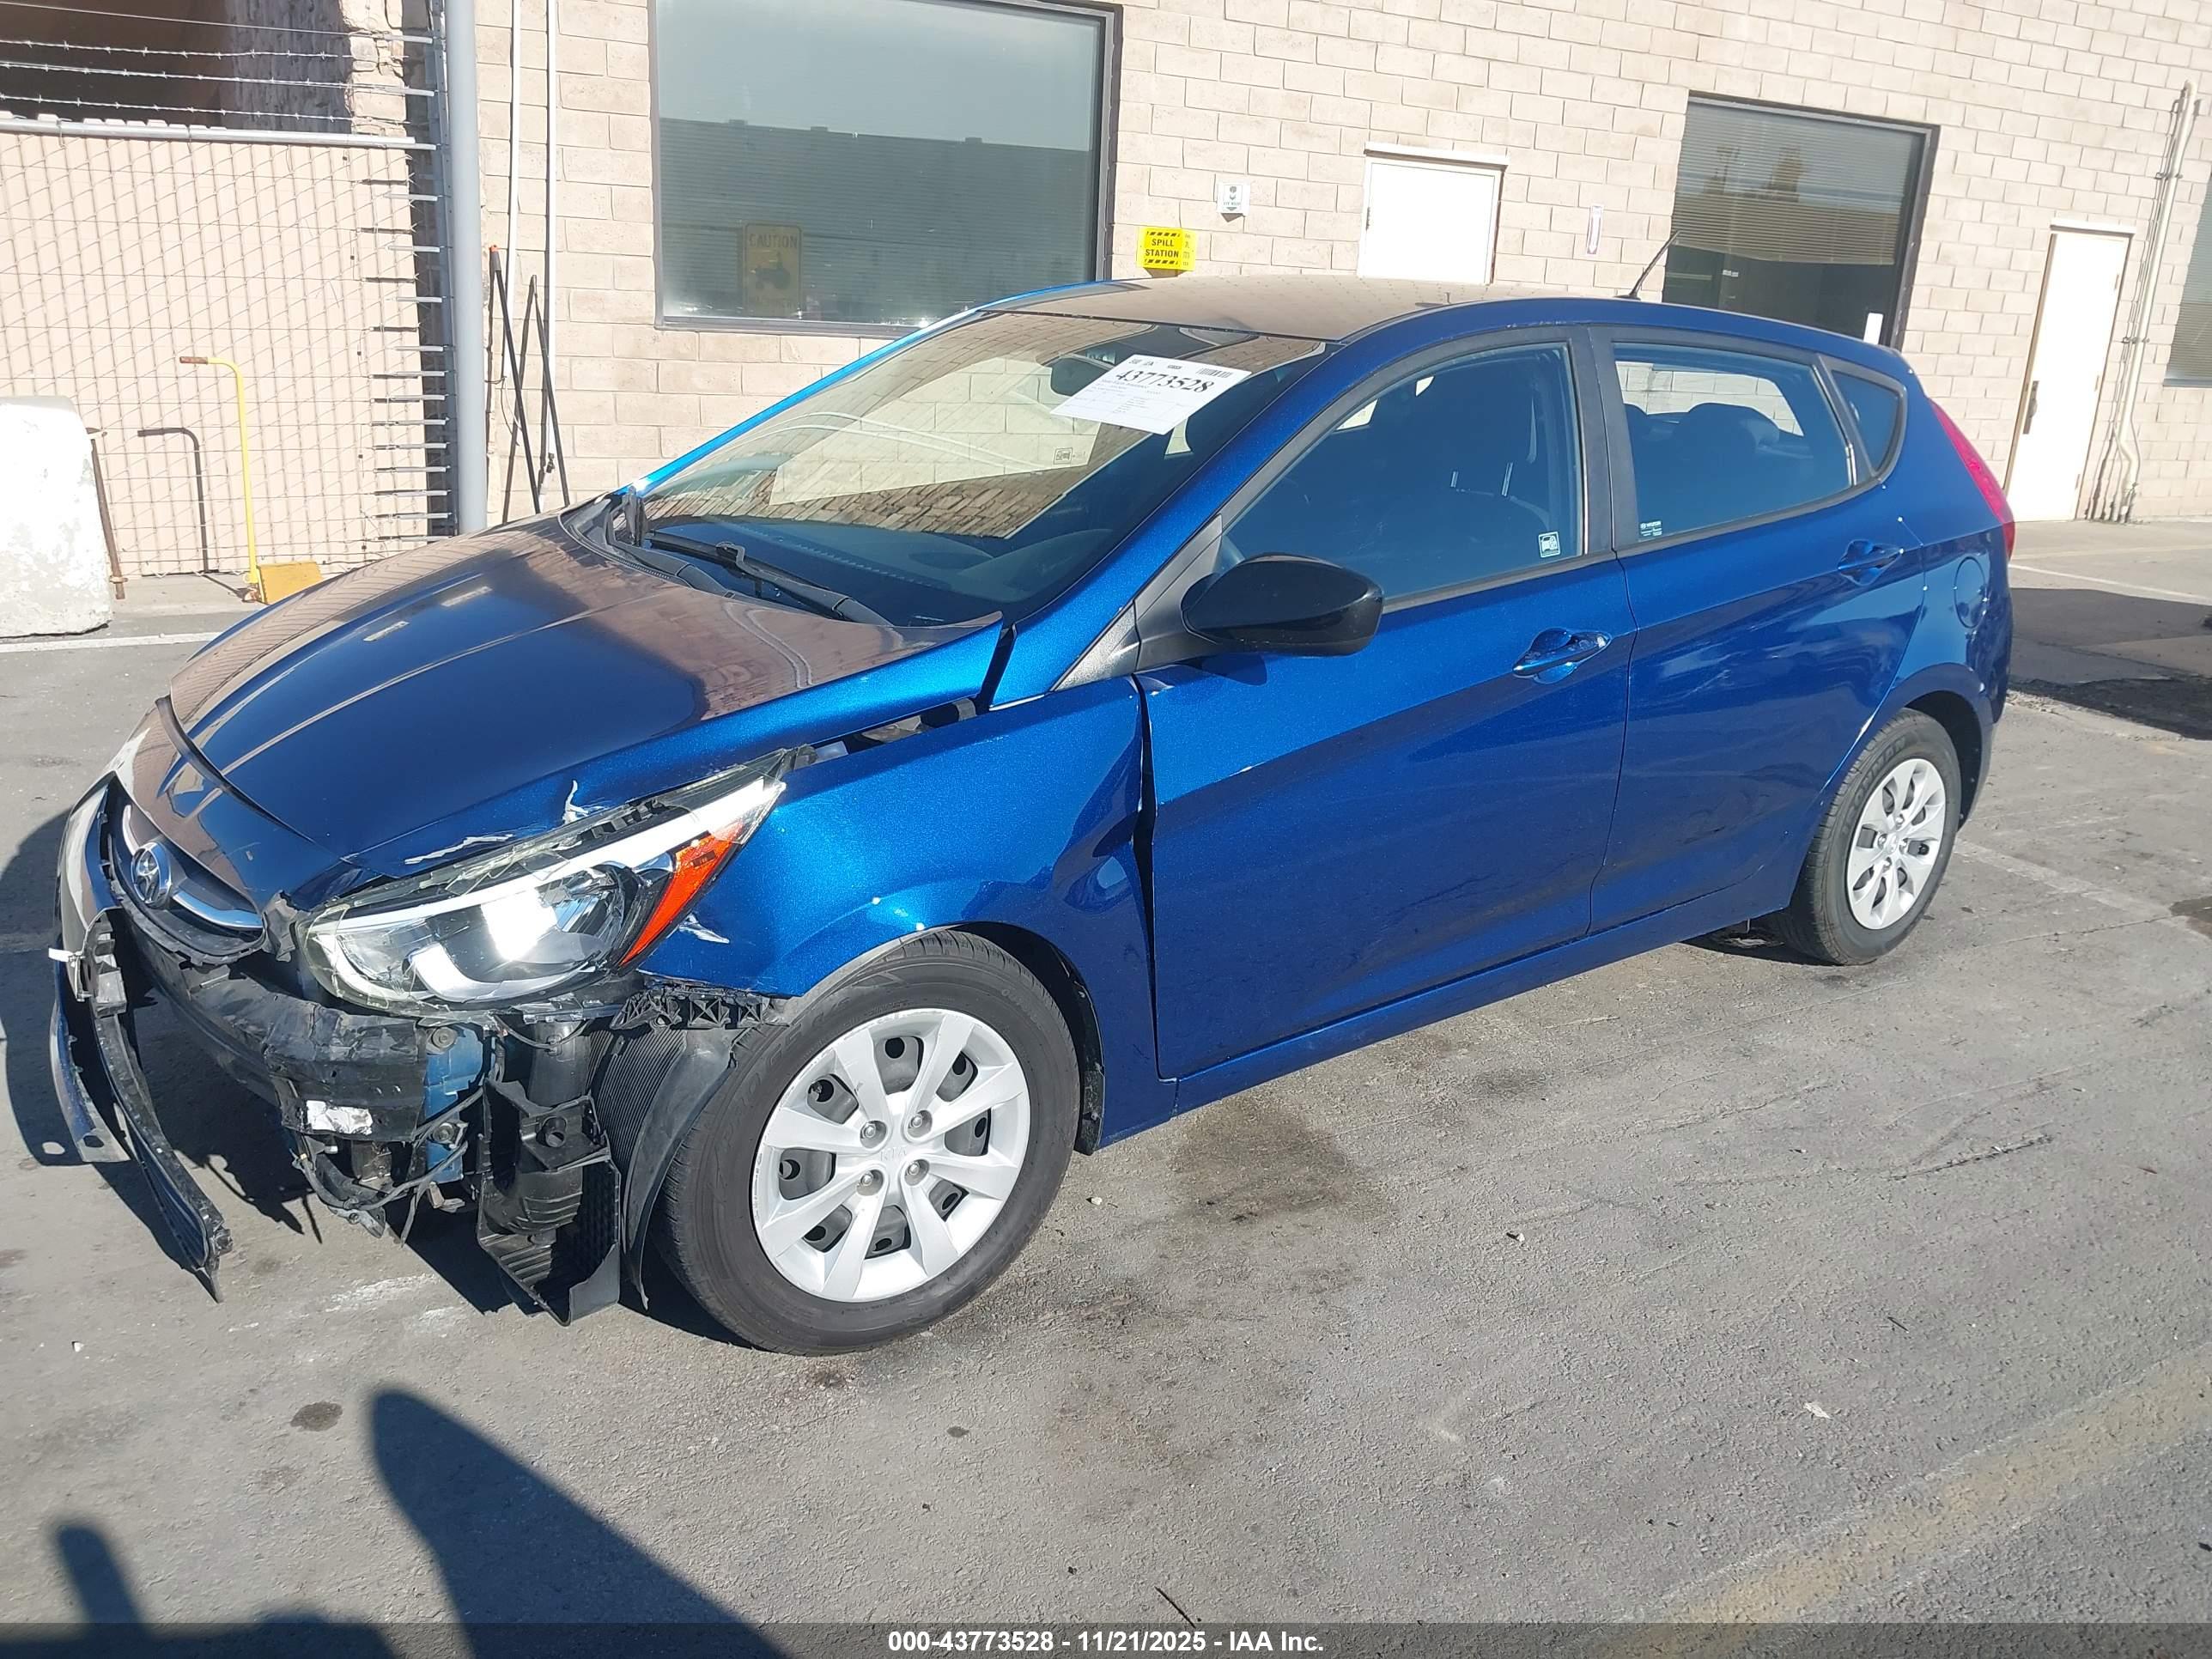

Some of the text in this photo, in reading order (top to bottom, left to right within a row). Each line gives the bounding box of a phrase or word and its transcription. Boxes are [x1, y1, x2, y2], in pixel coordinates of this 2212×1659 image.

[749, 233, 798, 250] CAUTION
[1152, 238, 1175, 247] SPILL
[1145, 248, 1179, 258] STATION
[1116, 369, 1214, 393] 43773528
